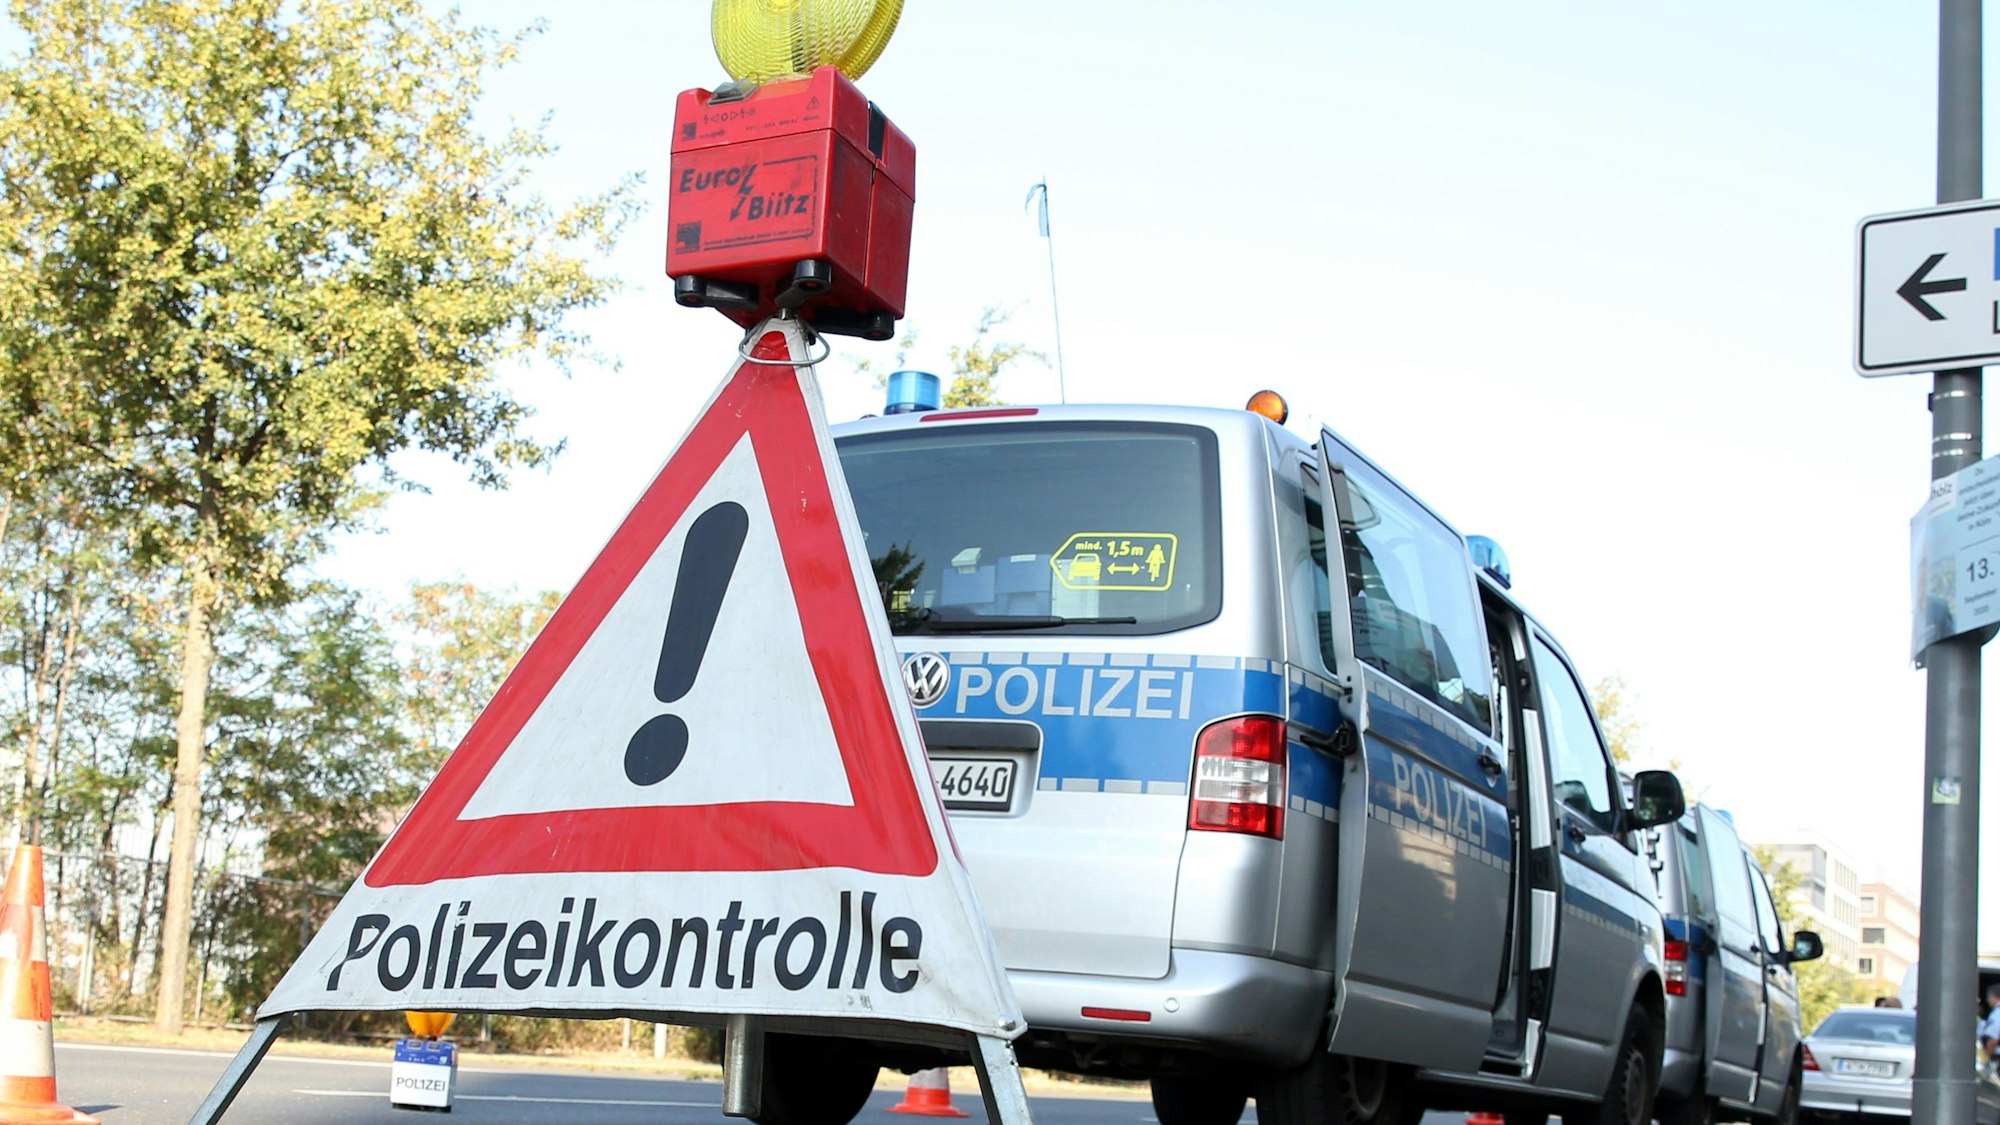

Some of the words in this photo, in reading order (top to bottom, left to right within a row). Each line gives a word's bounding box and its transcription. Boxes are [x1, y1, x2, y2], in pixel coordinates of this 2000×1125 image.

[680, 167, 741, 193] Euro
[1075, 541, 1103, 551] mind.
[1966, 557, 1995, 582] 13.
[955, 666, 1194, 720] POLIZEI
[1391, 751, 1487, 848] POLIZEI
[326, 891, 922, 993] Polizeikontrolle
[396, 1076, 446, 1092] POLIZEI
